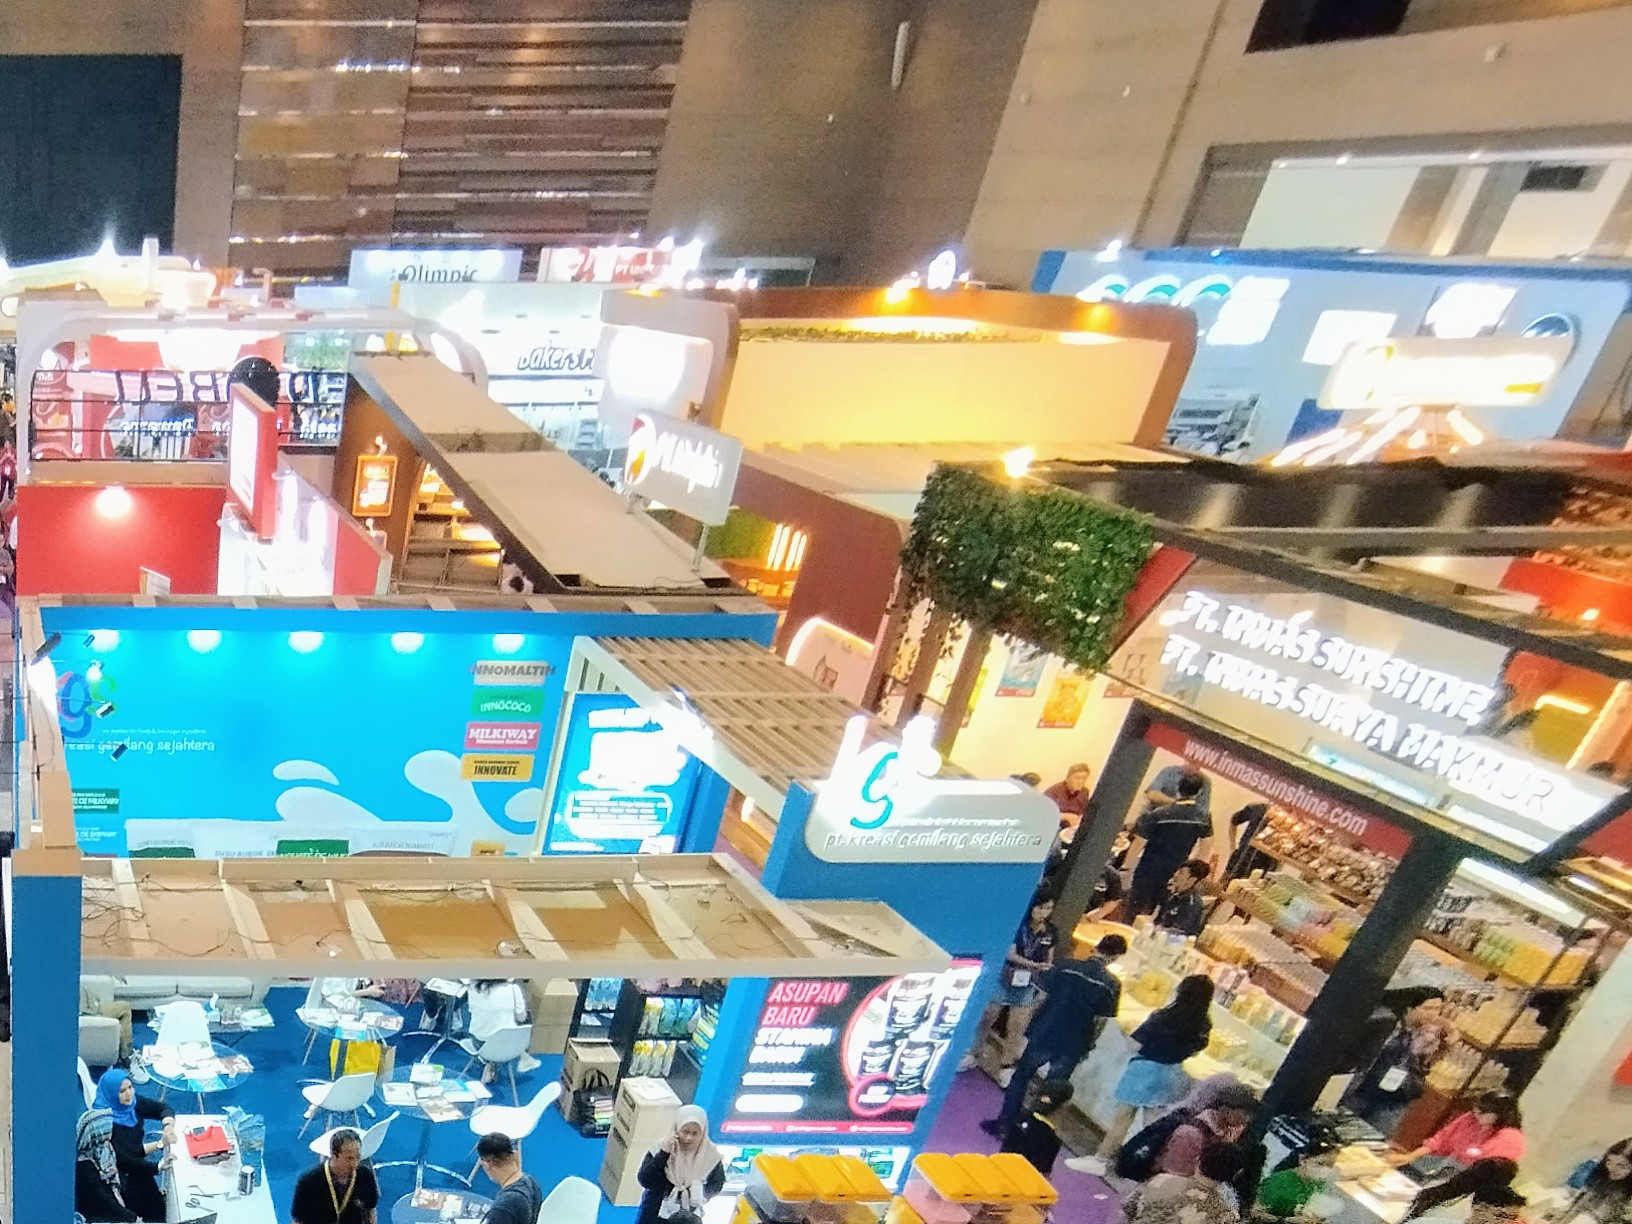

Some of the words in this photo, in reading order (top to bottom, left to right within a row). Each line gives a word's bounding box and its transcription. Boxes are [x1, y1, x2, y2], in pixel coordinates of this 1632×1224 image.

[480, 699, 532, 713] INNOCOCO
[469, 728, 537, 740] MILKIWAY
[156, 736, 215, 755] sejahtera
[474, 765, 518, 776] INNOVATE
[1184, 737, 1368, 836] www.inmassunshine.com
[771, 981, 848, 1003] ASUPAN
[762, 1006, 817, 1026] BARU
